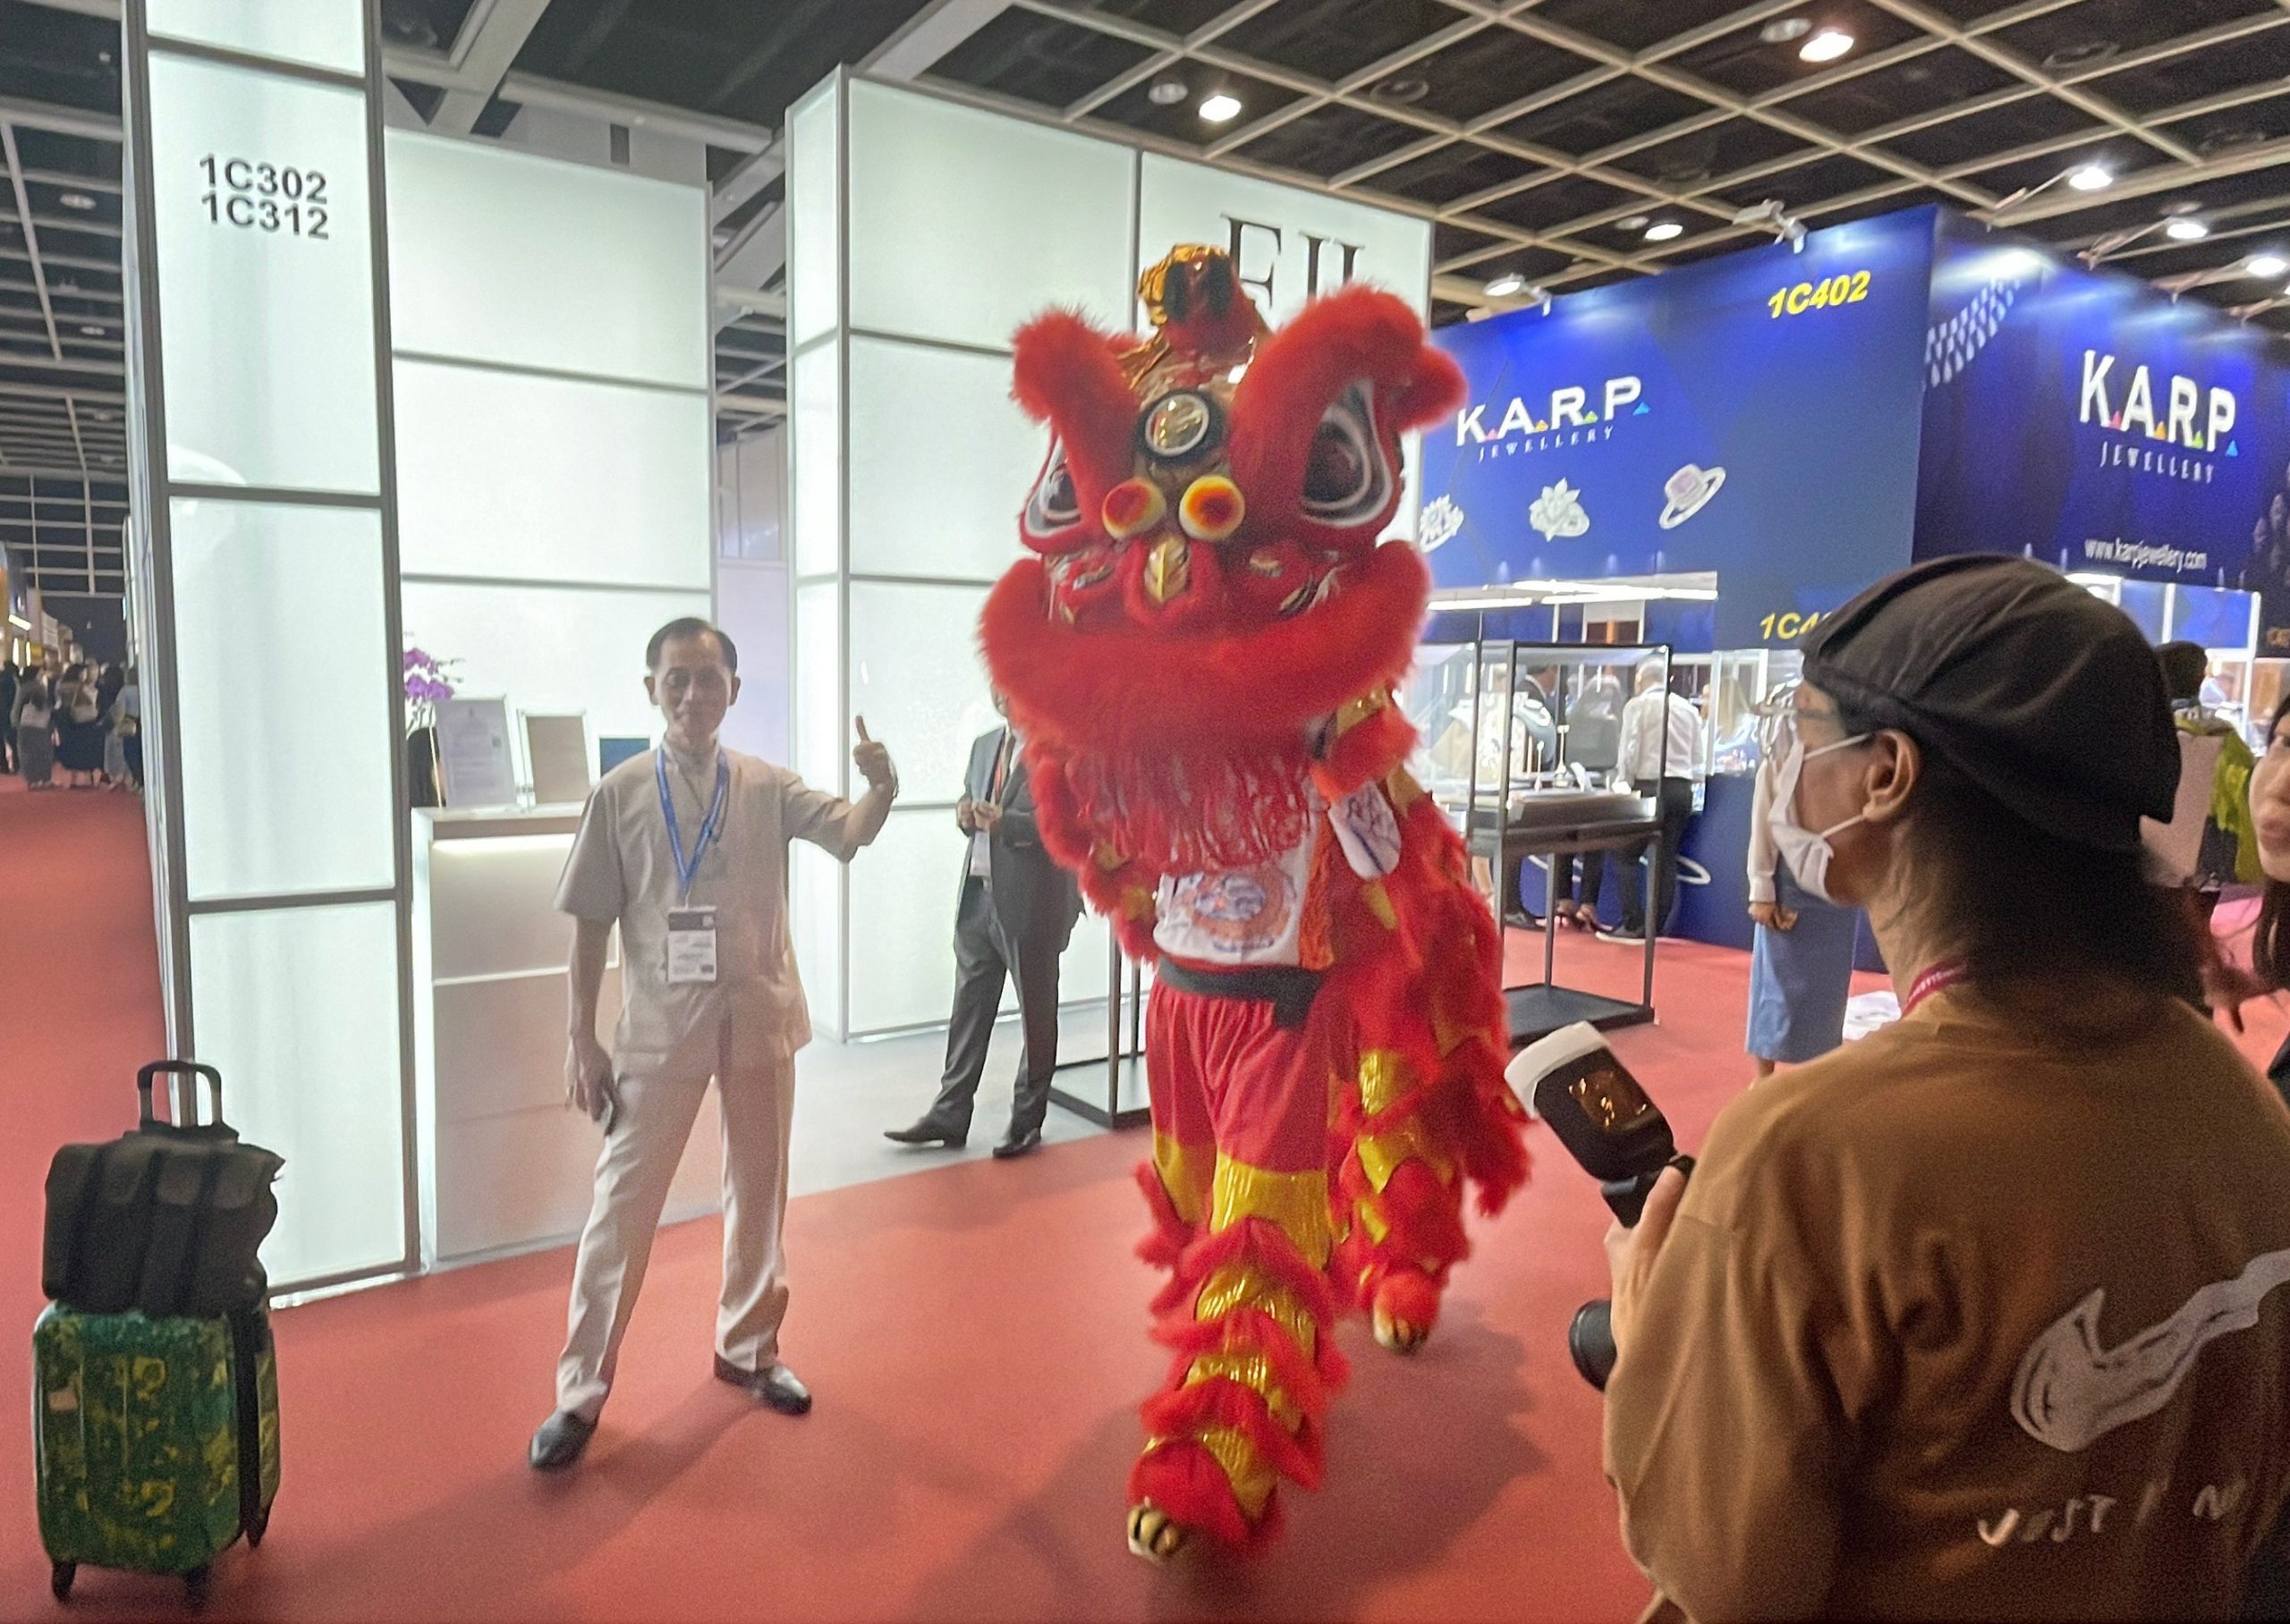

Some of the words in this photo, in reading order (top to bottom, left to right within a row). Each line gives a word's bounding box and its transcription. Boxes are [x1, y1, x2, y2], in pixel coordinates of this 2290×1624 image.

[199, 152, 327, 205] 1C302
[201, 190, 329, 240] 1C312
[1768, 270, 1871, 318] 1C402
[1478, 425, 1614, 463] JEWELLERY
[2099, 441, 2215, 484] JEWELLERY
[1760, 611, 1833, 640] 1C4
